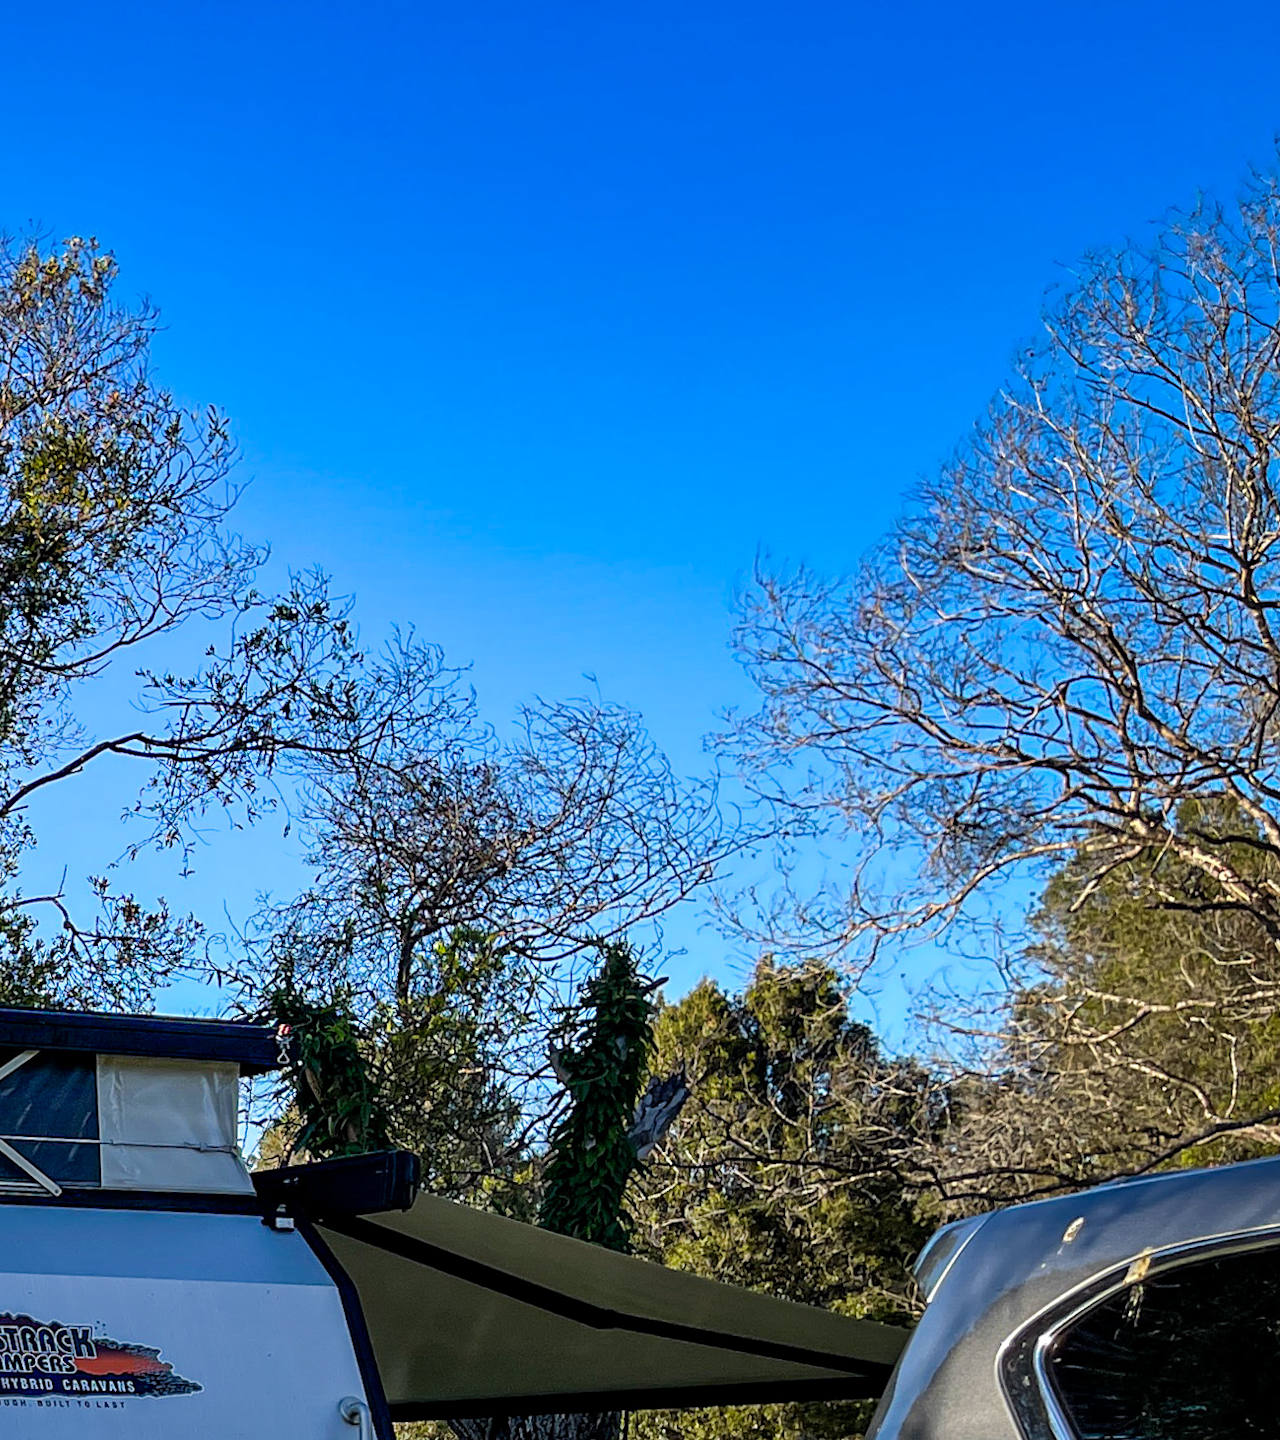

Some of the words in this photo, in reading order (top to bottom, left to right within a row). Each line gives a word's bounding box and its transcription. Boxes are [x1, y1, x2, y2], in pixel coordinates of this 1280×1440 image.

[1, 1377, 54, 1391] HYBRID
[62, 1379, 136, 1393] CARAVANS
[96, 1401, 126, 1409] LAST
